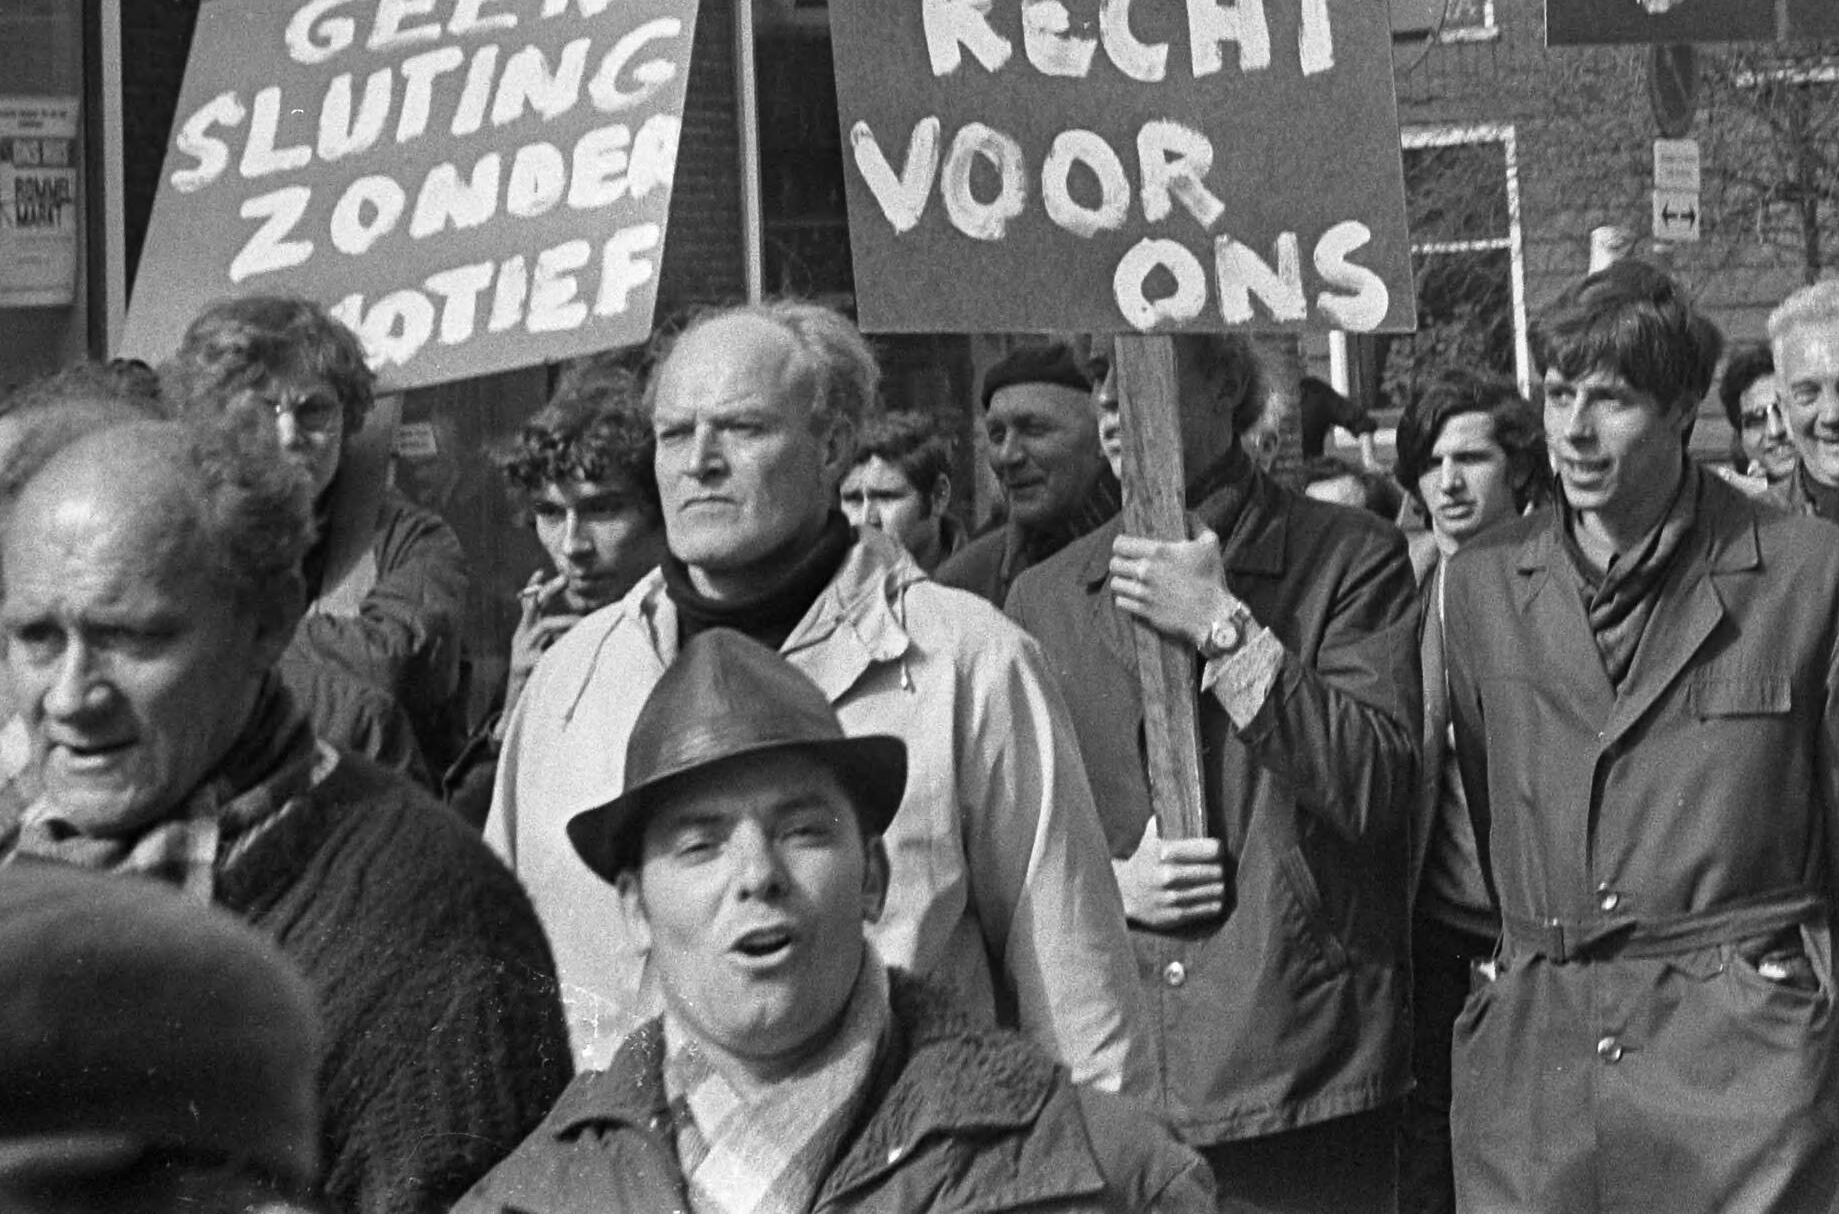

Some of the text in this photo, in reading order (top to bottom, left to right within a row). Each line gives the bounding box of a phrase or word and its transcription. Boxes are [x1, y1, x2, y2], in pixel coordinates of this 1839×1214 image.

[171, 17, 682, 192] SLUTING
[229, 113, 683, 284] ZONDER
[850, 117, 1225, 239] VOOR
[1113, 220, 1389, 332] ONS
